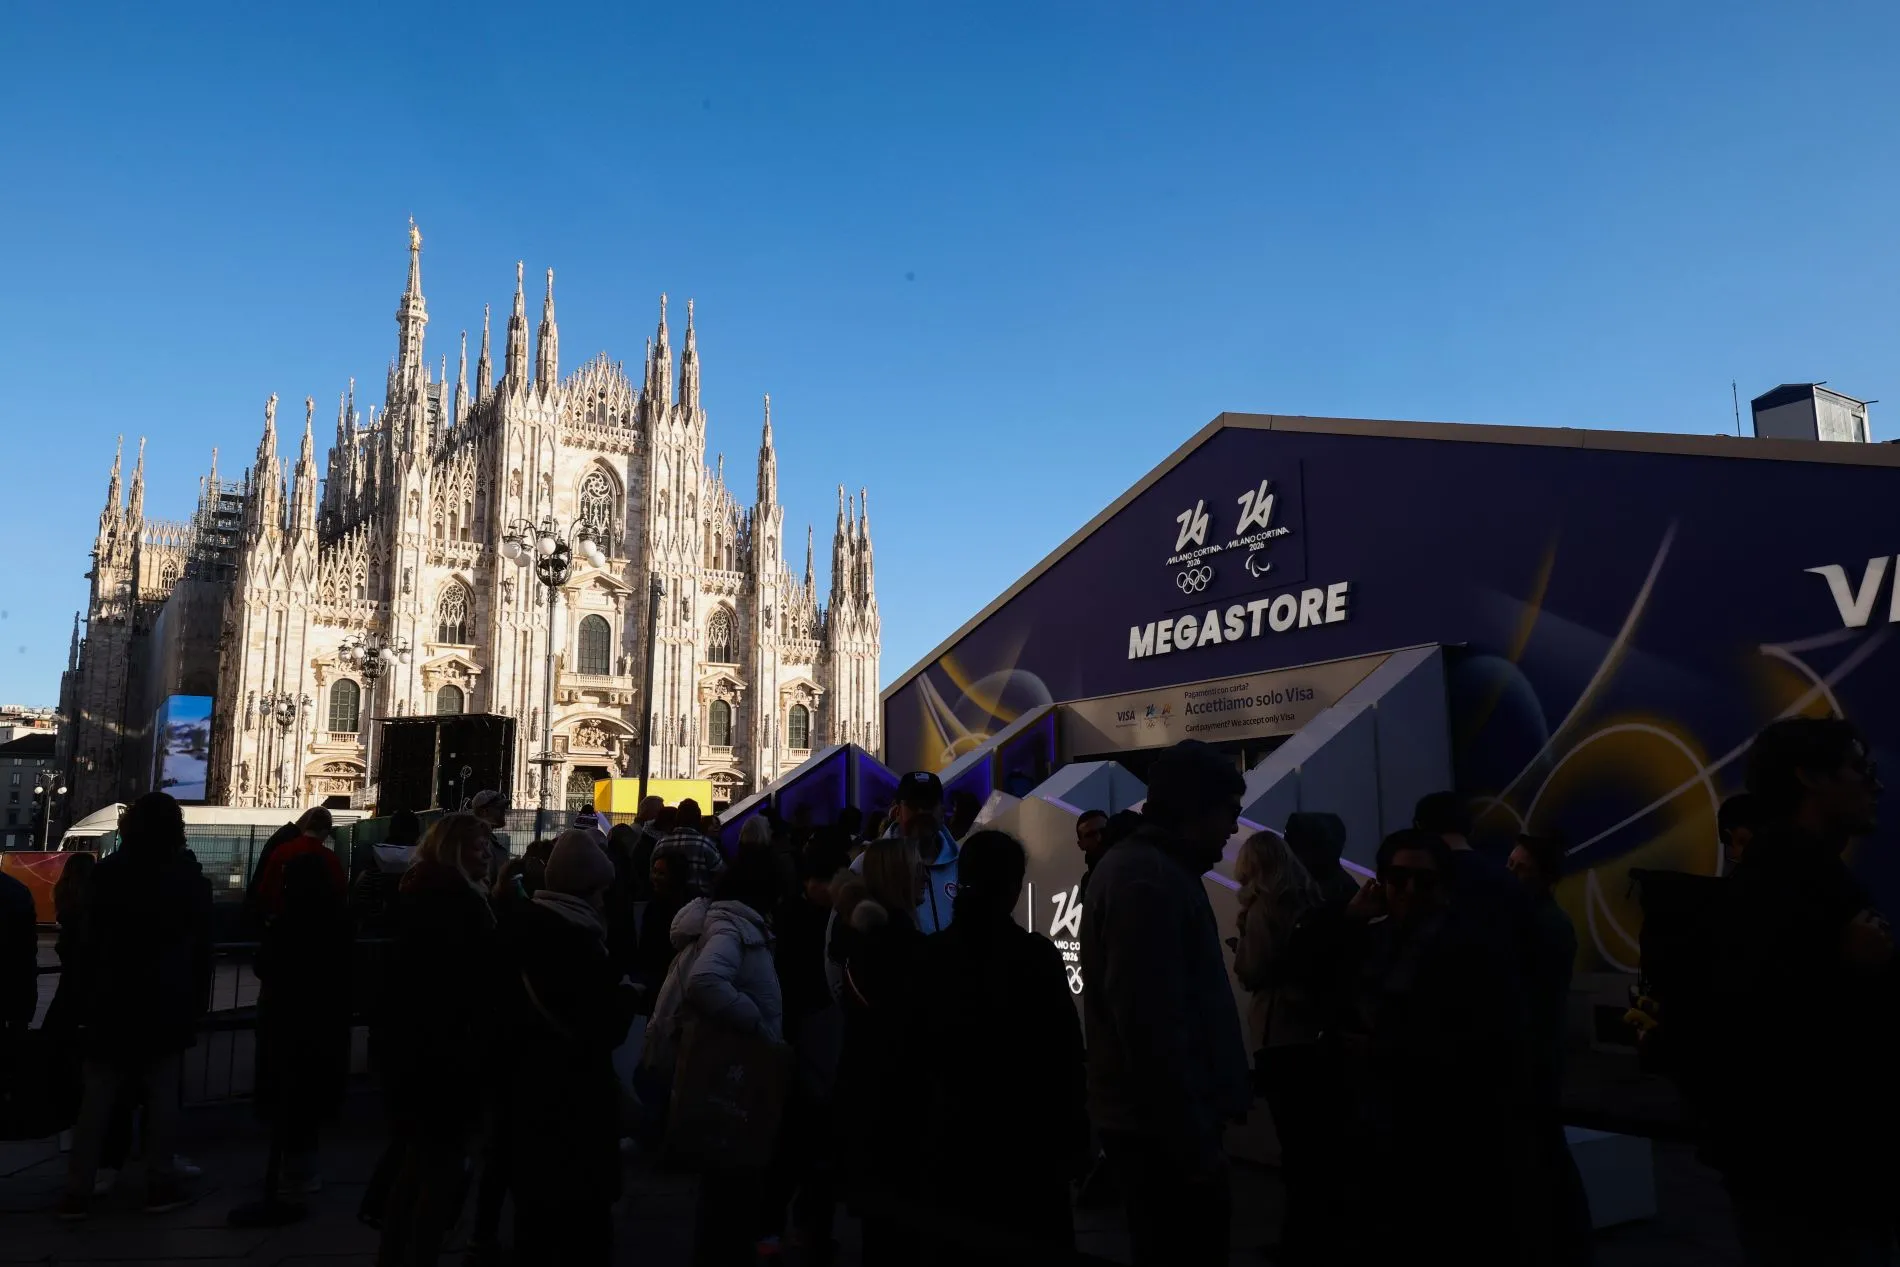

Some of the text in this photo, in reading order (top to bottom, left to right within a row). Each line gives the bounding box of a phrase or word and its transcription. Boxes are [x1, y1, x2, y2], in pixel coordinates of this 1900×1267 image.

[1226, 526, 1290, 550] MILANO CORTINA
[1249, 542, 1265, 552] 2026
[1166, 544, 1223, 566] MILANO CORTINA
[1187, 559, 1201, 568] 2026
[1127, 581, 1349, 660] MEGASTORE
[1185, 696, 1254, 716] Accettiamo
[1256, 690, 1283, 707] solo
[1285, 687, 1314, 702] Visa
[1116, 711, 1136, 722] VISA
[1231, 719, 1242, 727] We
[1242, 716, 1265, 727] accept
[1265, 714, 1280, 724] only
[1280, 713, 1295, 721] Visa
[1069, 941, 1081, 951] CO
[1062, 951, 1079, 962] 2026
